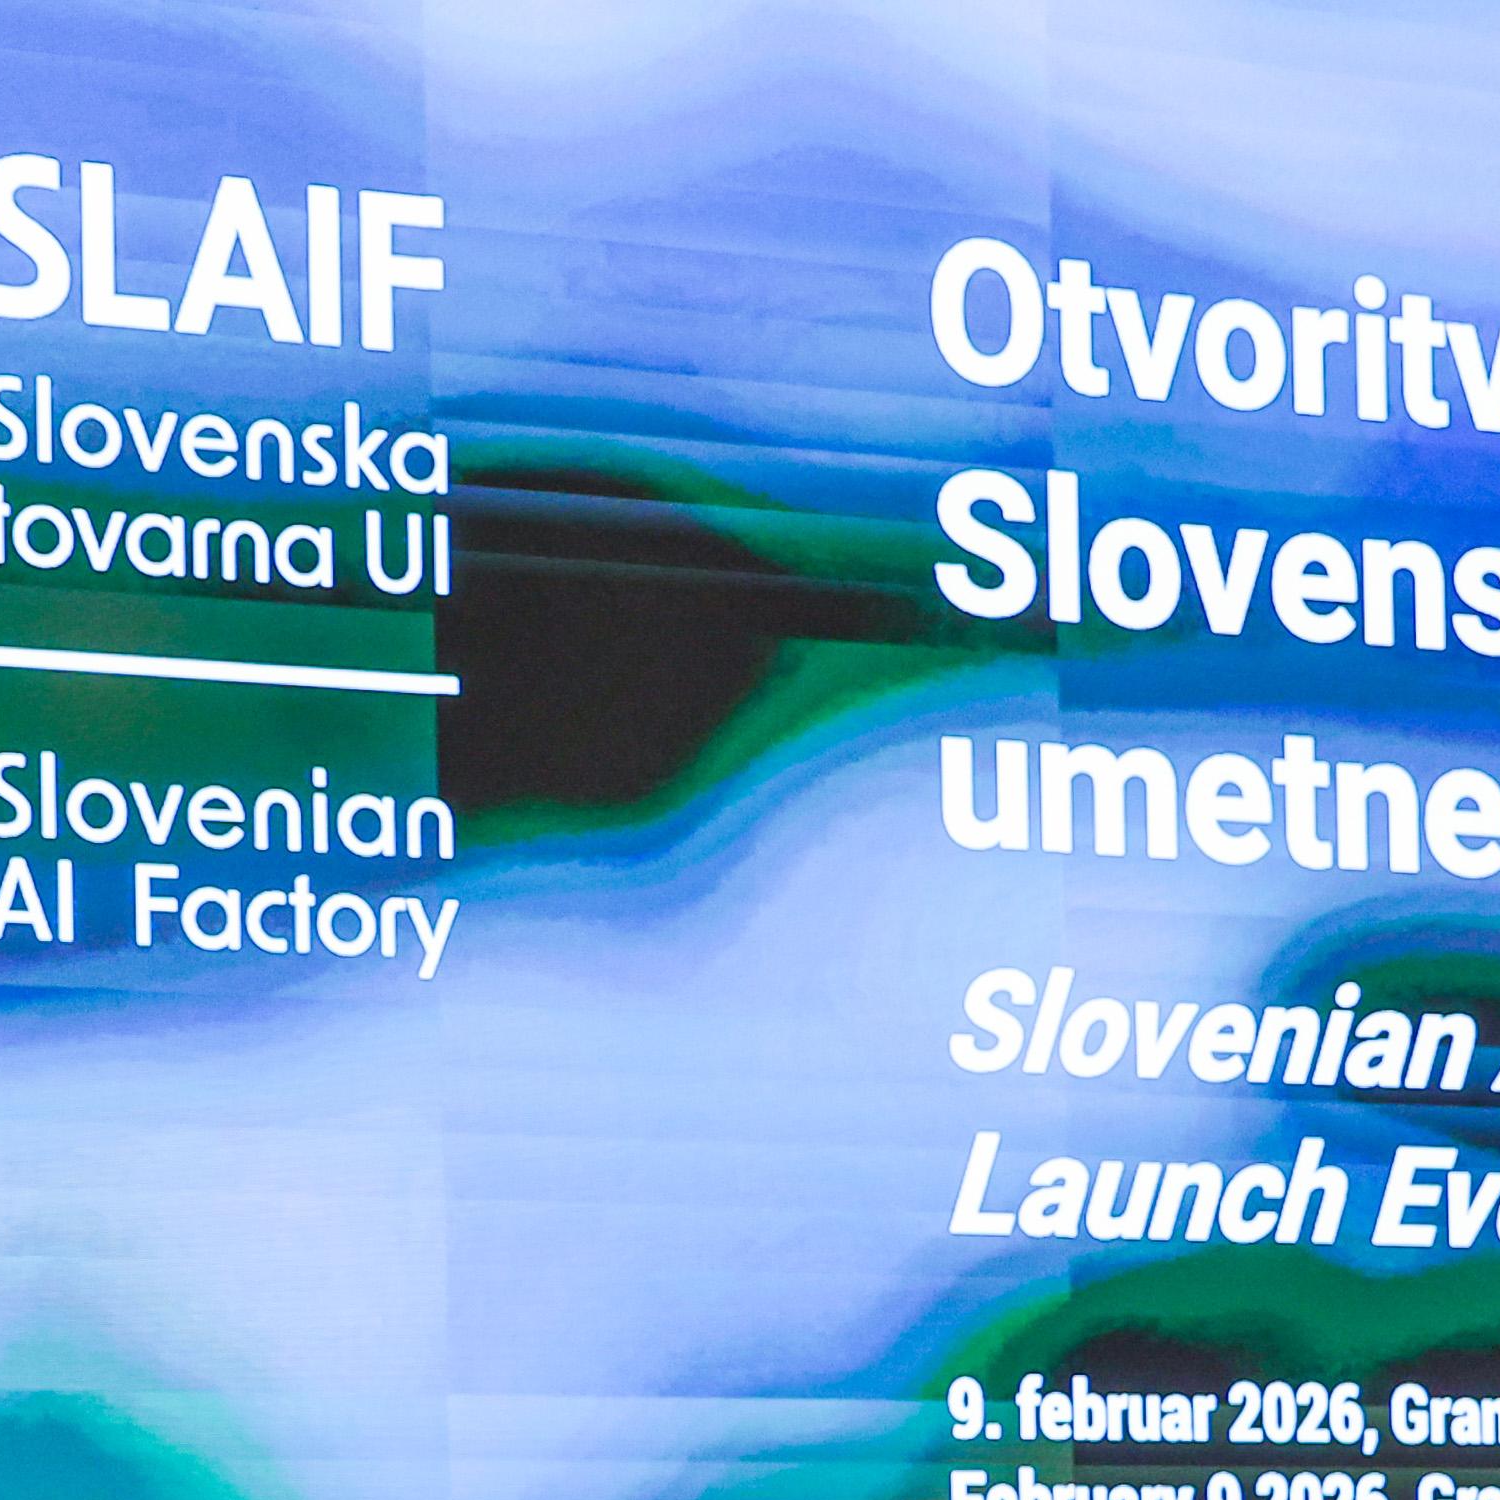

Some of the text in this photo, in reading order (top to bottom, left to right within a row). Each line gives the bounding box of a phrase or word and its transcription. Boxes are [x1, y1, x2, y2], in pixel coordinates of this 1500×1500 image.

[365, 509, 452, 596] UI
[134, 862, 461, 981] Factory
[948, 965, 1478, 1090] Slovenian
[948, 1130, 1349, 1245] Launch
[946, 1374, 1002, 1442] 9.
[1015, 1373, 1218, 1443] februar
[1228, 1380, 1380, 1456] 2026,
